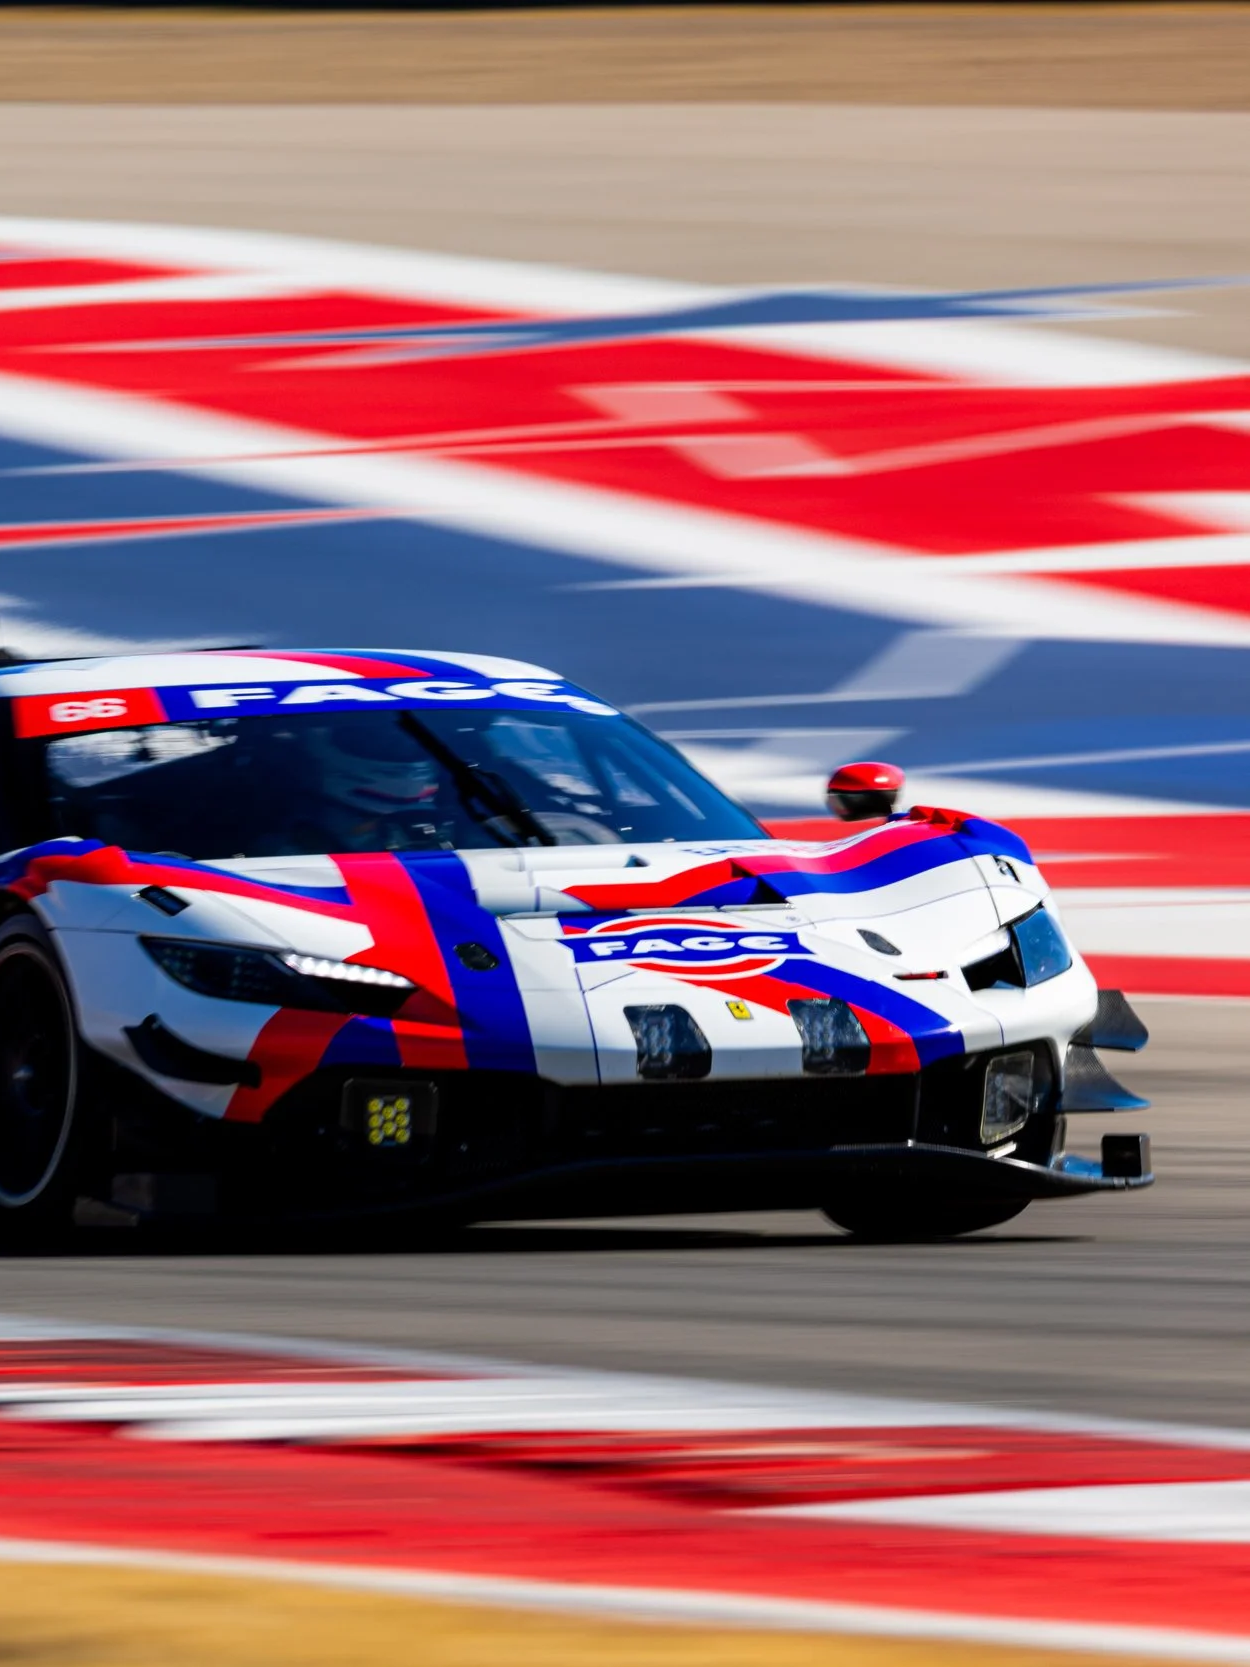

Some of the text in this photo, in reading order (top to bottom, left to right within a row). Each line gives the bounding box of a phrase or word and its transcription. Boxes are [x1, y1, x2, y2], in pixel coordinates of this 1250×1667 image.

[49, 697, 128, 722] 66
[189, 681, 620, 716] FAGE
[588, 936, 790, 957] FAGE
